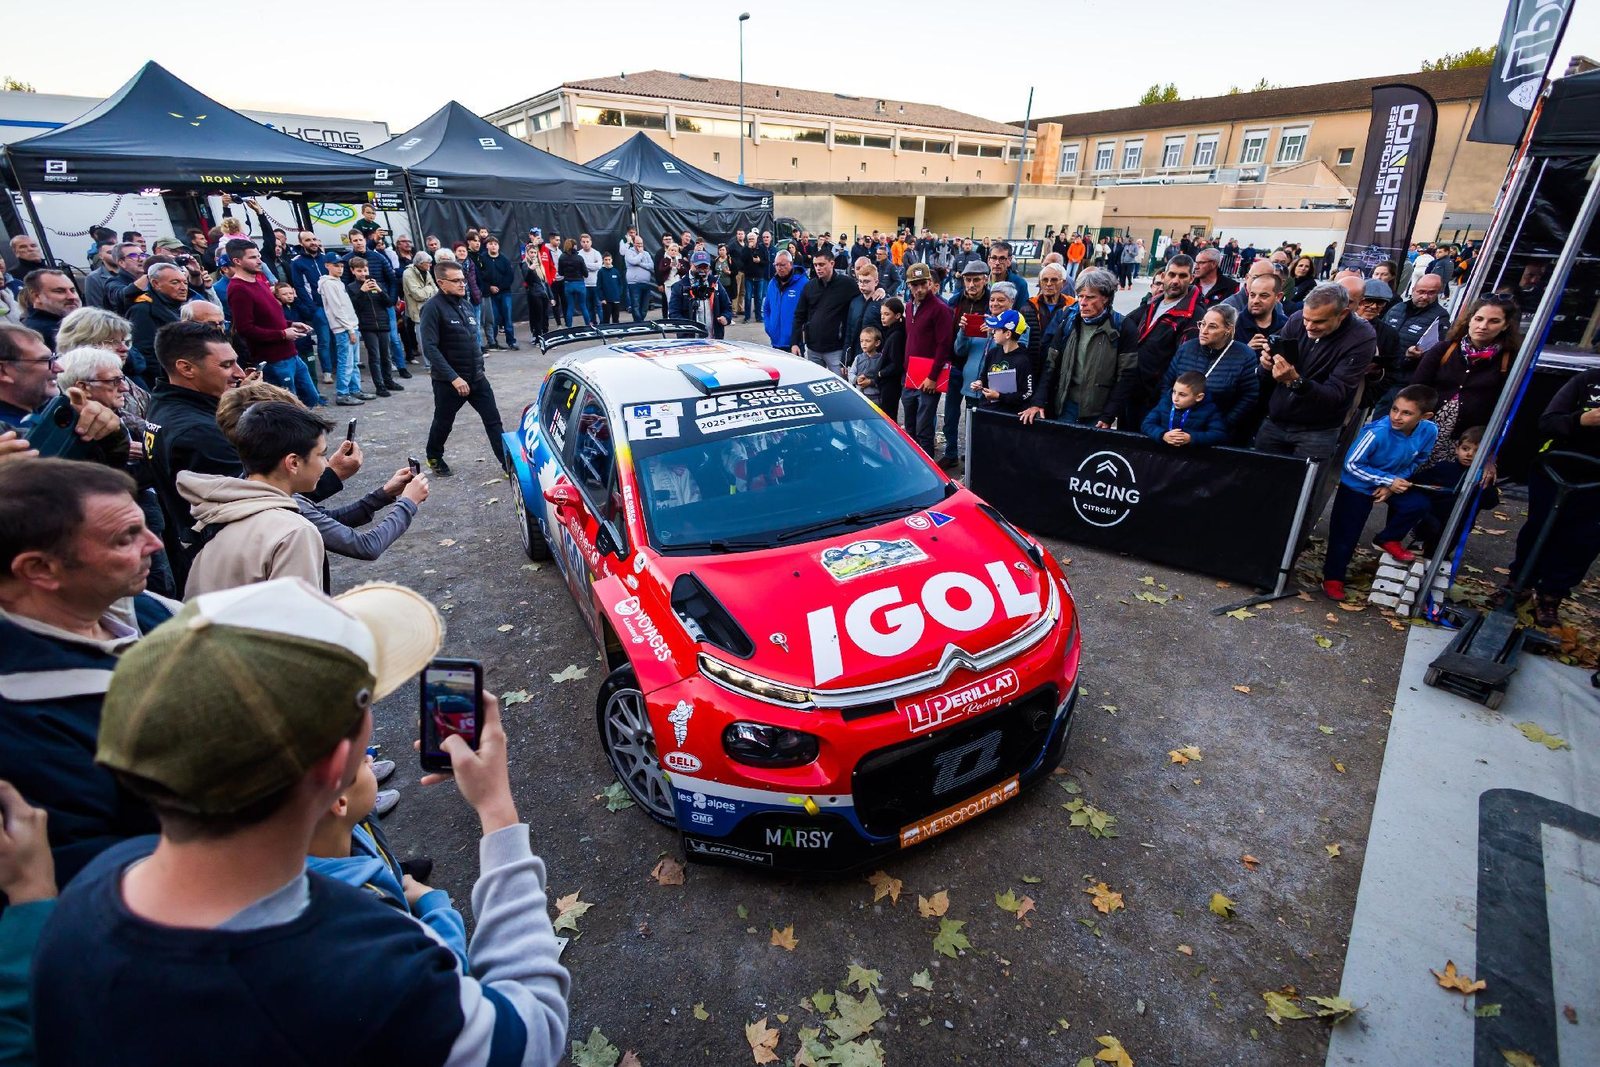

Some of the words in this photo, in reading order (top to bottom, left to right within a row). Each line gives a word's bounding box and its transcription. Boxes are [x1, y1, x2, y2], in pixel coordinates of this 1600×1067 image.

[200, 176, 232, 184] IRON
[254, 176, 284, 184] LYNX
[314, 208, 350, 217] YACCO
[566, 384, 577, 409] 2
[740, 388, 799, 400] ORECA
[749, 394, 805, 407] STORE
[701, 418, 726, 429] 2025
[767, 405, 817, 418] CANAL+
[644, 418, 663, 437] 2
[1068, 476, 1140, 504] RACING
[1082, 503, 1117, 515] CITROËN
[860, 544, 868, 552] 2
[806, 560, 1042, 686] IGOL
[635, 608, 672, 662] VOYAGES
[962, 695, 1002, 716] Racing
[669, 755, 696, 768] BELL
[677, 791, 692, 803] les
[707, 799, 736, 811] alpes
[691, 813, 714, 823] OMP
[922, 789, 1003, 837] METROPOLITAN
[765, 827, 834, 849] MARSY
[709, 846, 764, 862] MICHELIN
